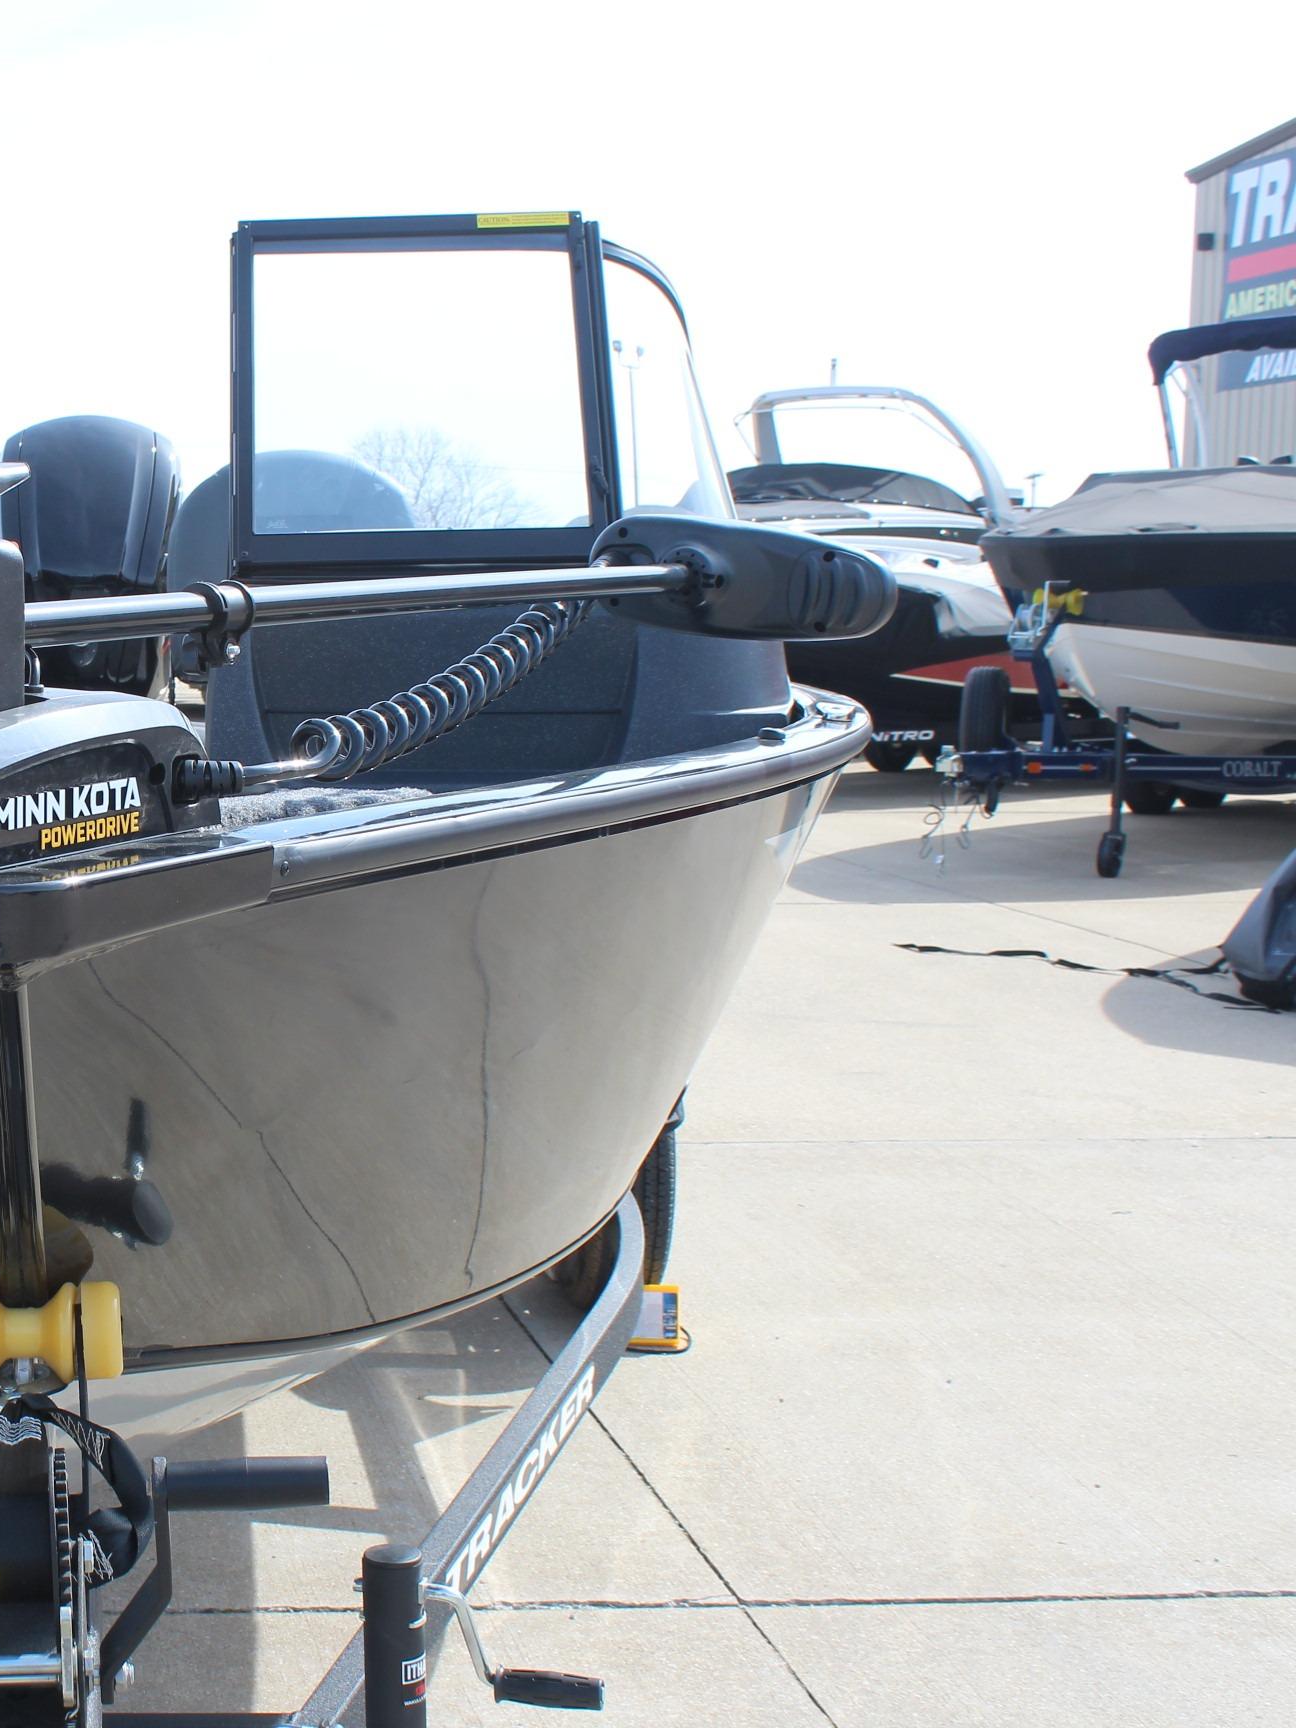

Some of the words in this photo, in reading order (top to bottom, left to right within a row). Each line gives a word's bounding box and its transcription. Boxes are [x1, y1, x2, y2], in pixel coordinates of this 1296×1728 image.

[1223, 760, 1281, 777] COBALT
[72, 776, 142, 819] KOTA
[40, 811, 140, 850] POWERDRIVE
[444, 1360, 596, 1594] TRACKER
